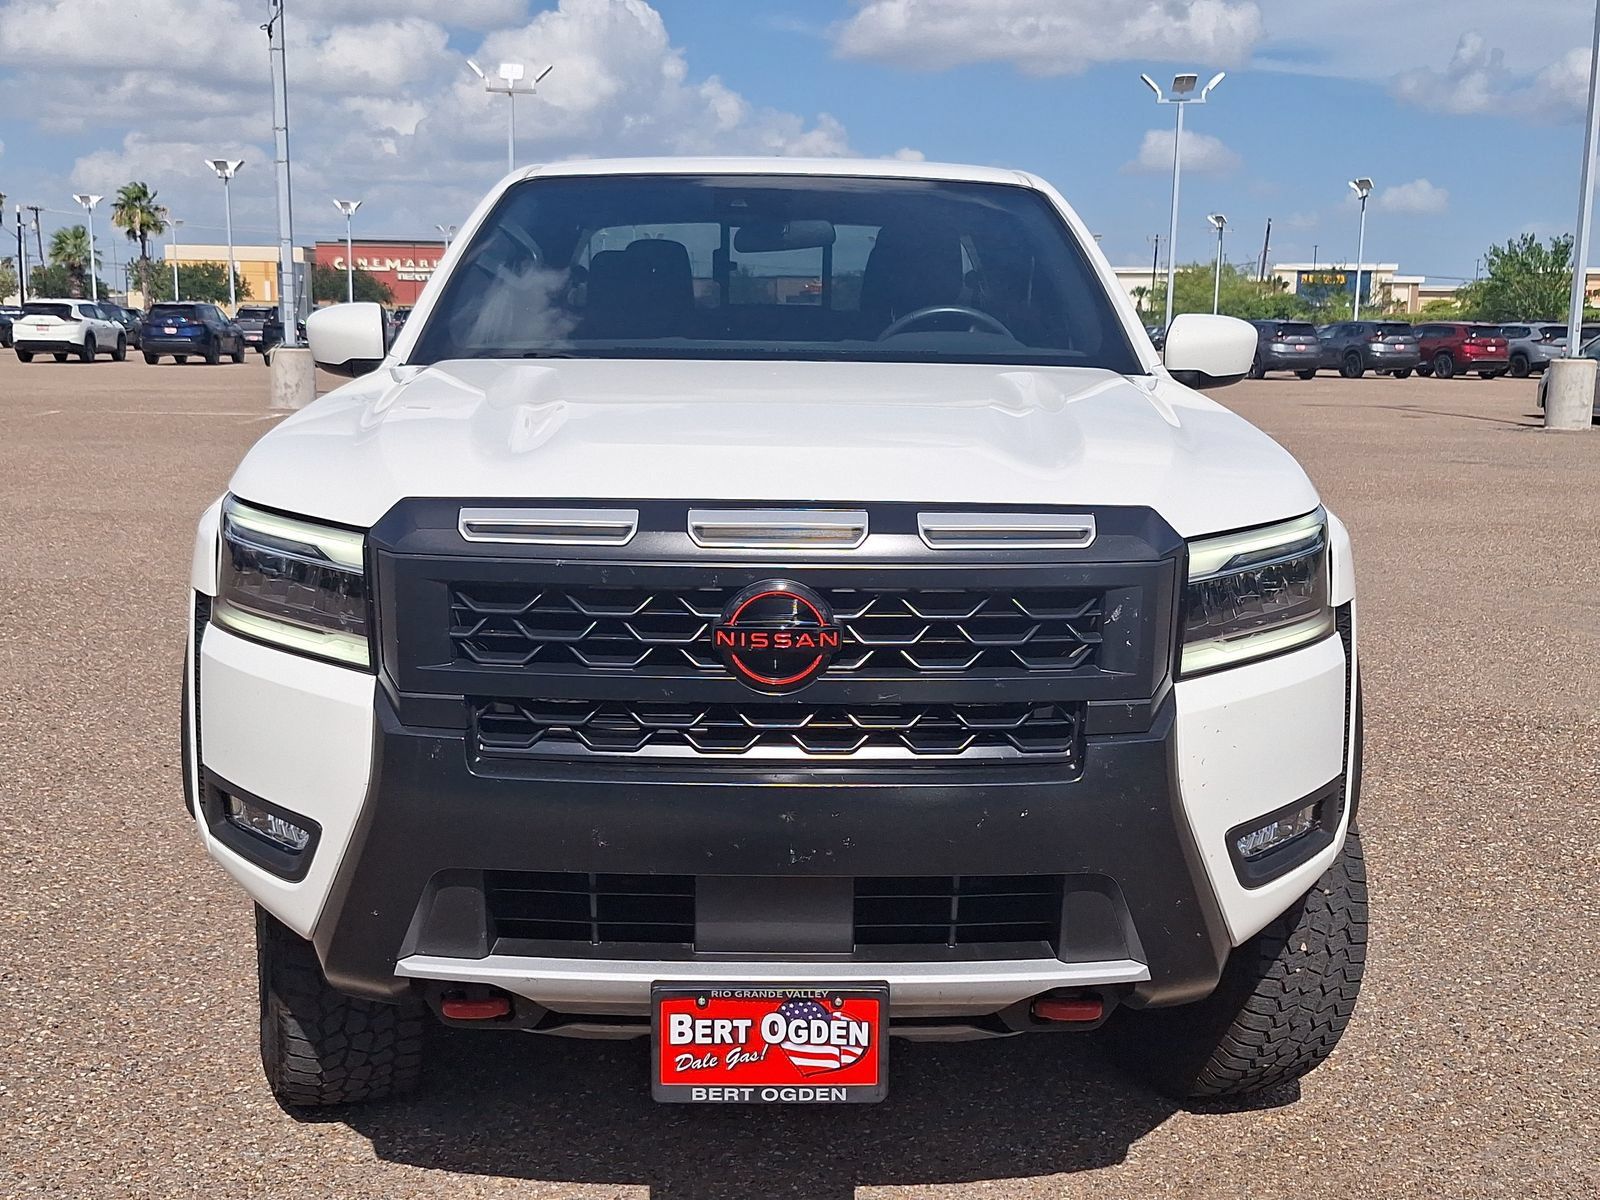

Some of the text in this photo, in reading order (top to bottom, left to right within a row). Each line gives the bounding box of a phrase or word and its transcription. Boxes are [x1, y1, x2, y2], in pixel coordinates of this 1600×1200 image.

[716, 630, 838, 648] NISSAN
[711, 990, 829, 998] RIO GRANDE VALLEY
[669, 1012, 869, 1047] BERT OGDEN
[674, 1044, 769, 1072] Dale Gas!
[691, 1088, 847, 1101] BERT OGDEN
